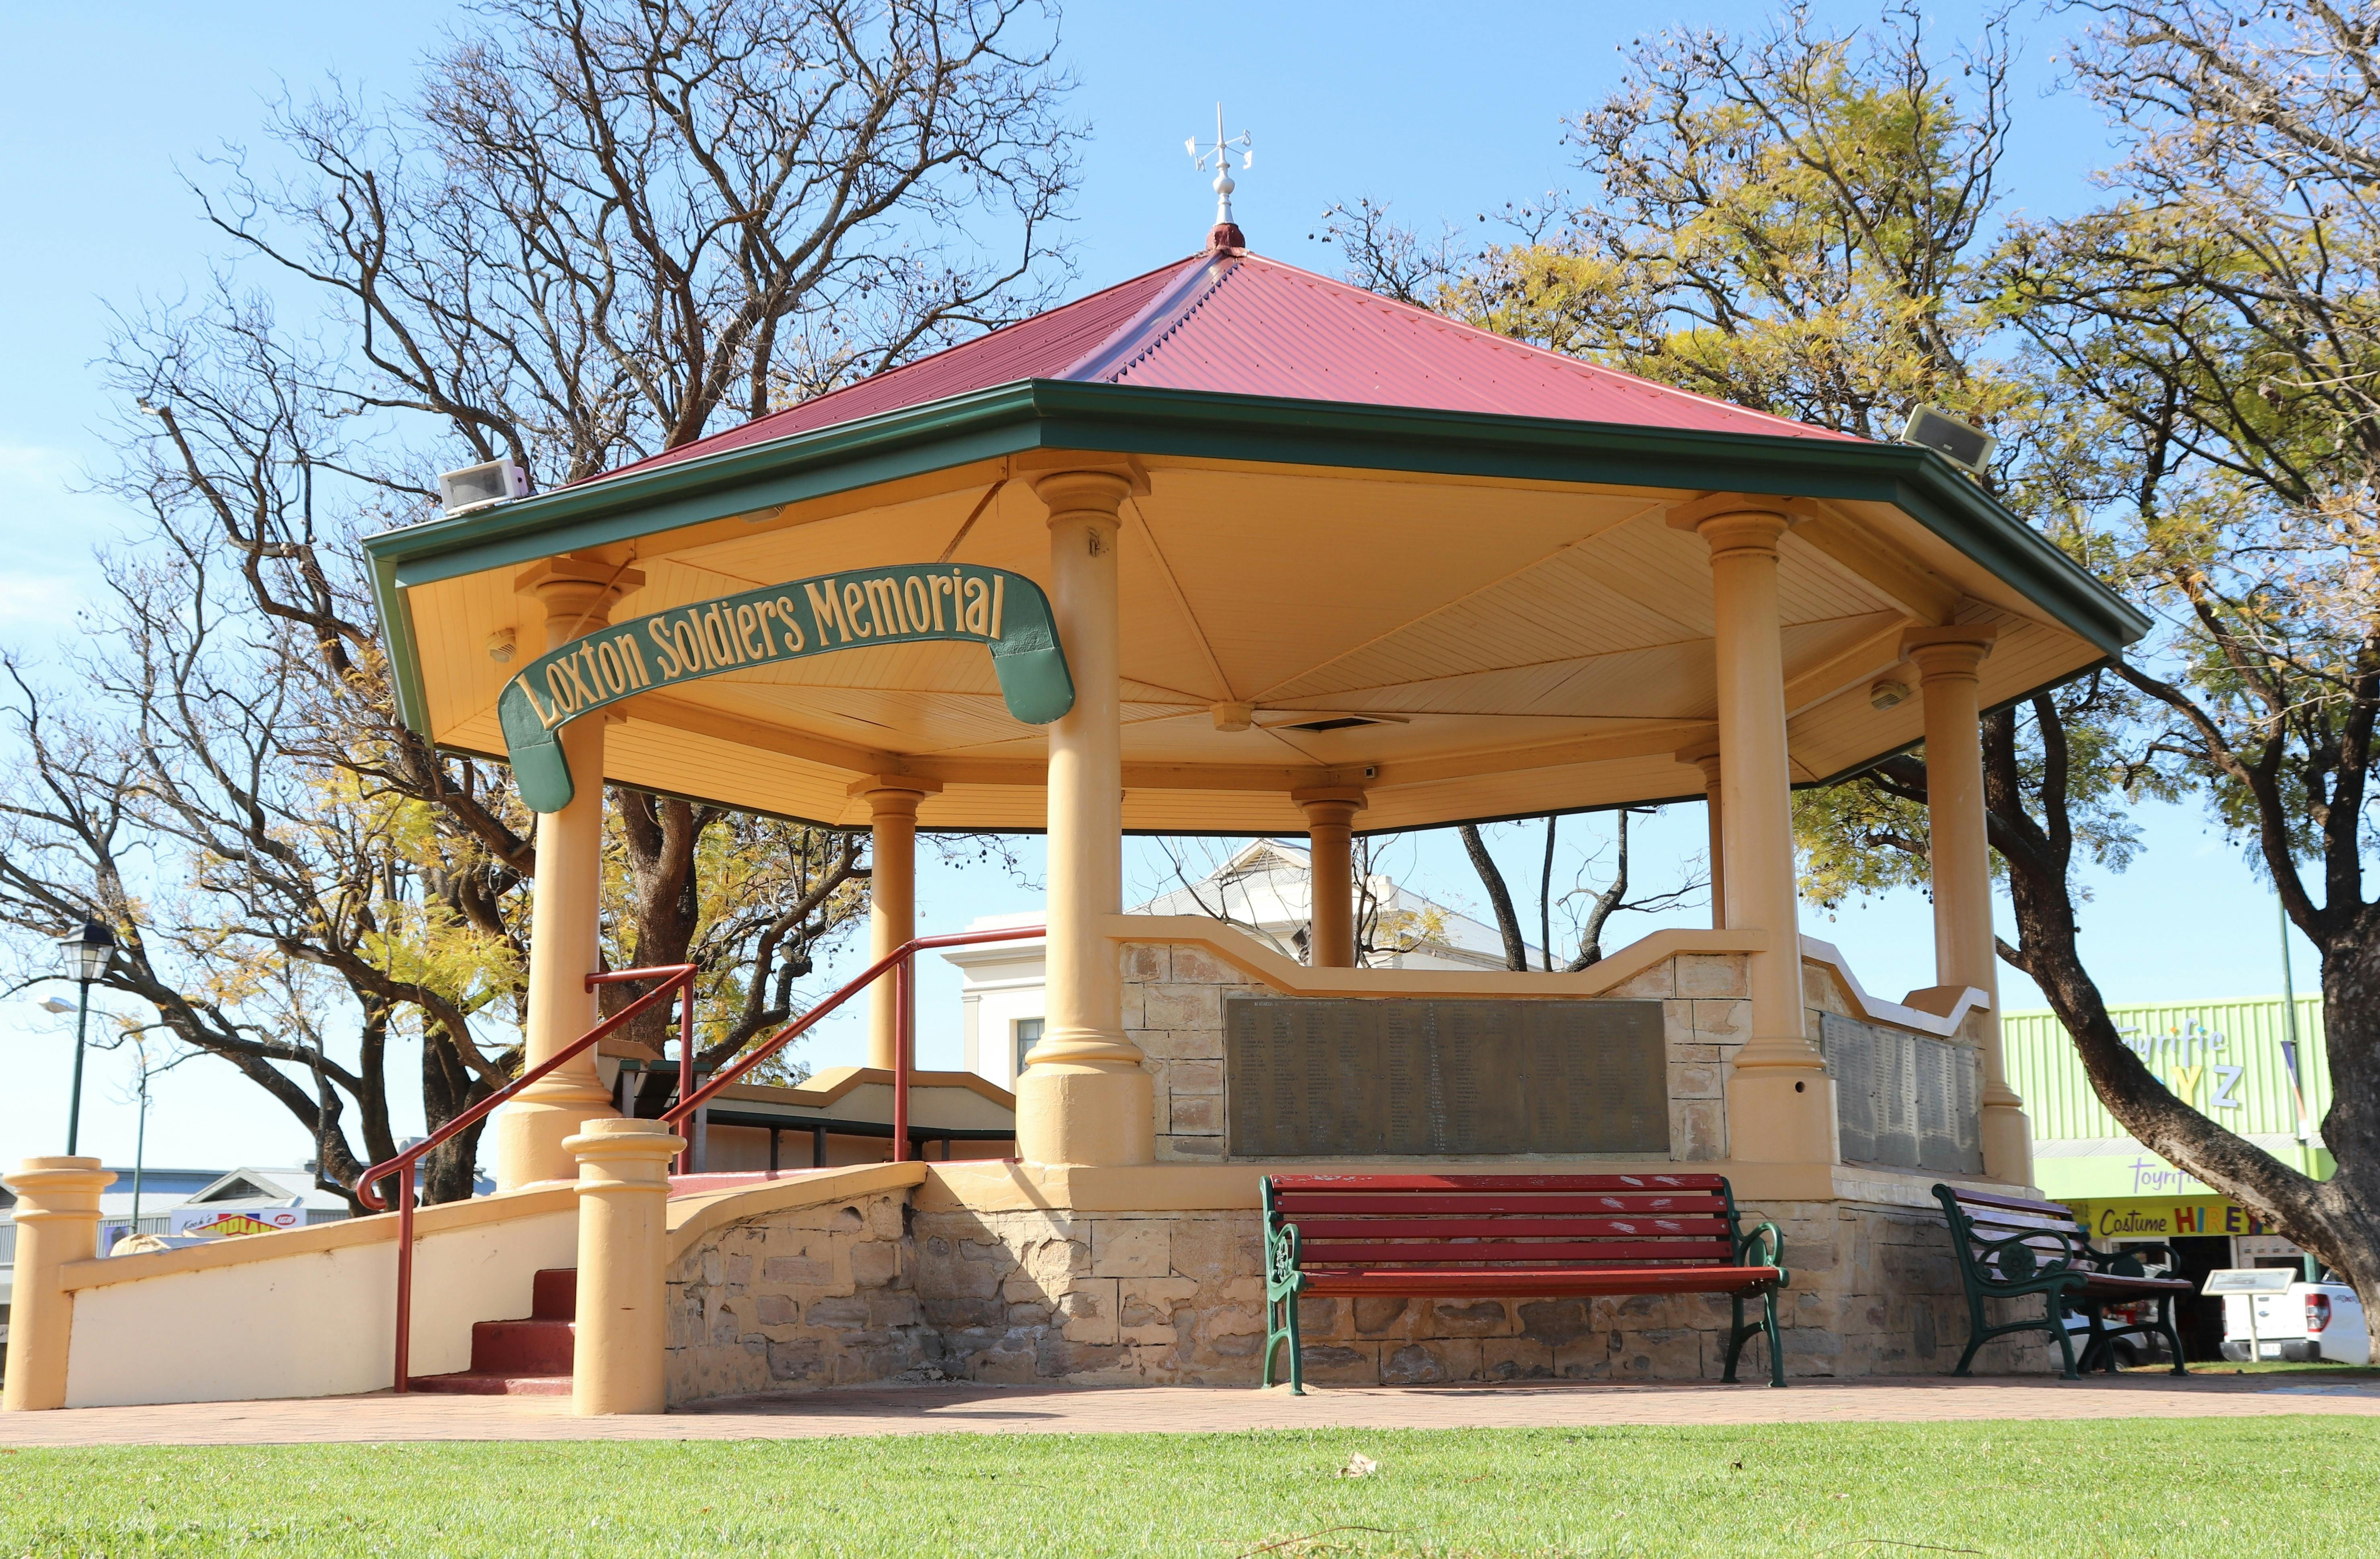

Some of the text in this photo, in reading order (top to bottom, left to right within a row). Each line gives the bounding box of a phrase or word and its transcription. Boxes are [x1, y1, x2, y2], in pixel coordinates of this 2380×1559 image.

[515, 567, 1005, 729] Loxton Soldiers Memorial
[2100, 1206, 2241, 1236] Costume HIRE
